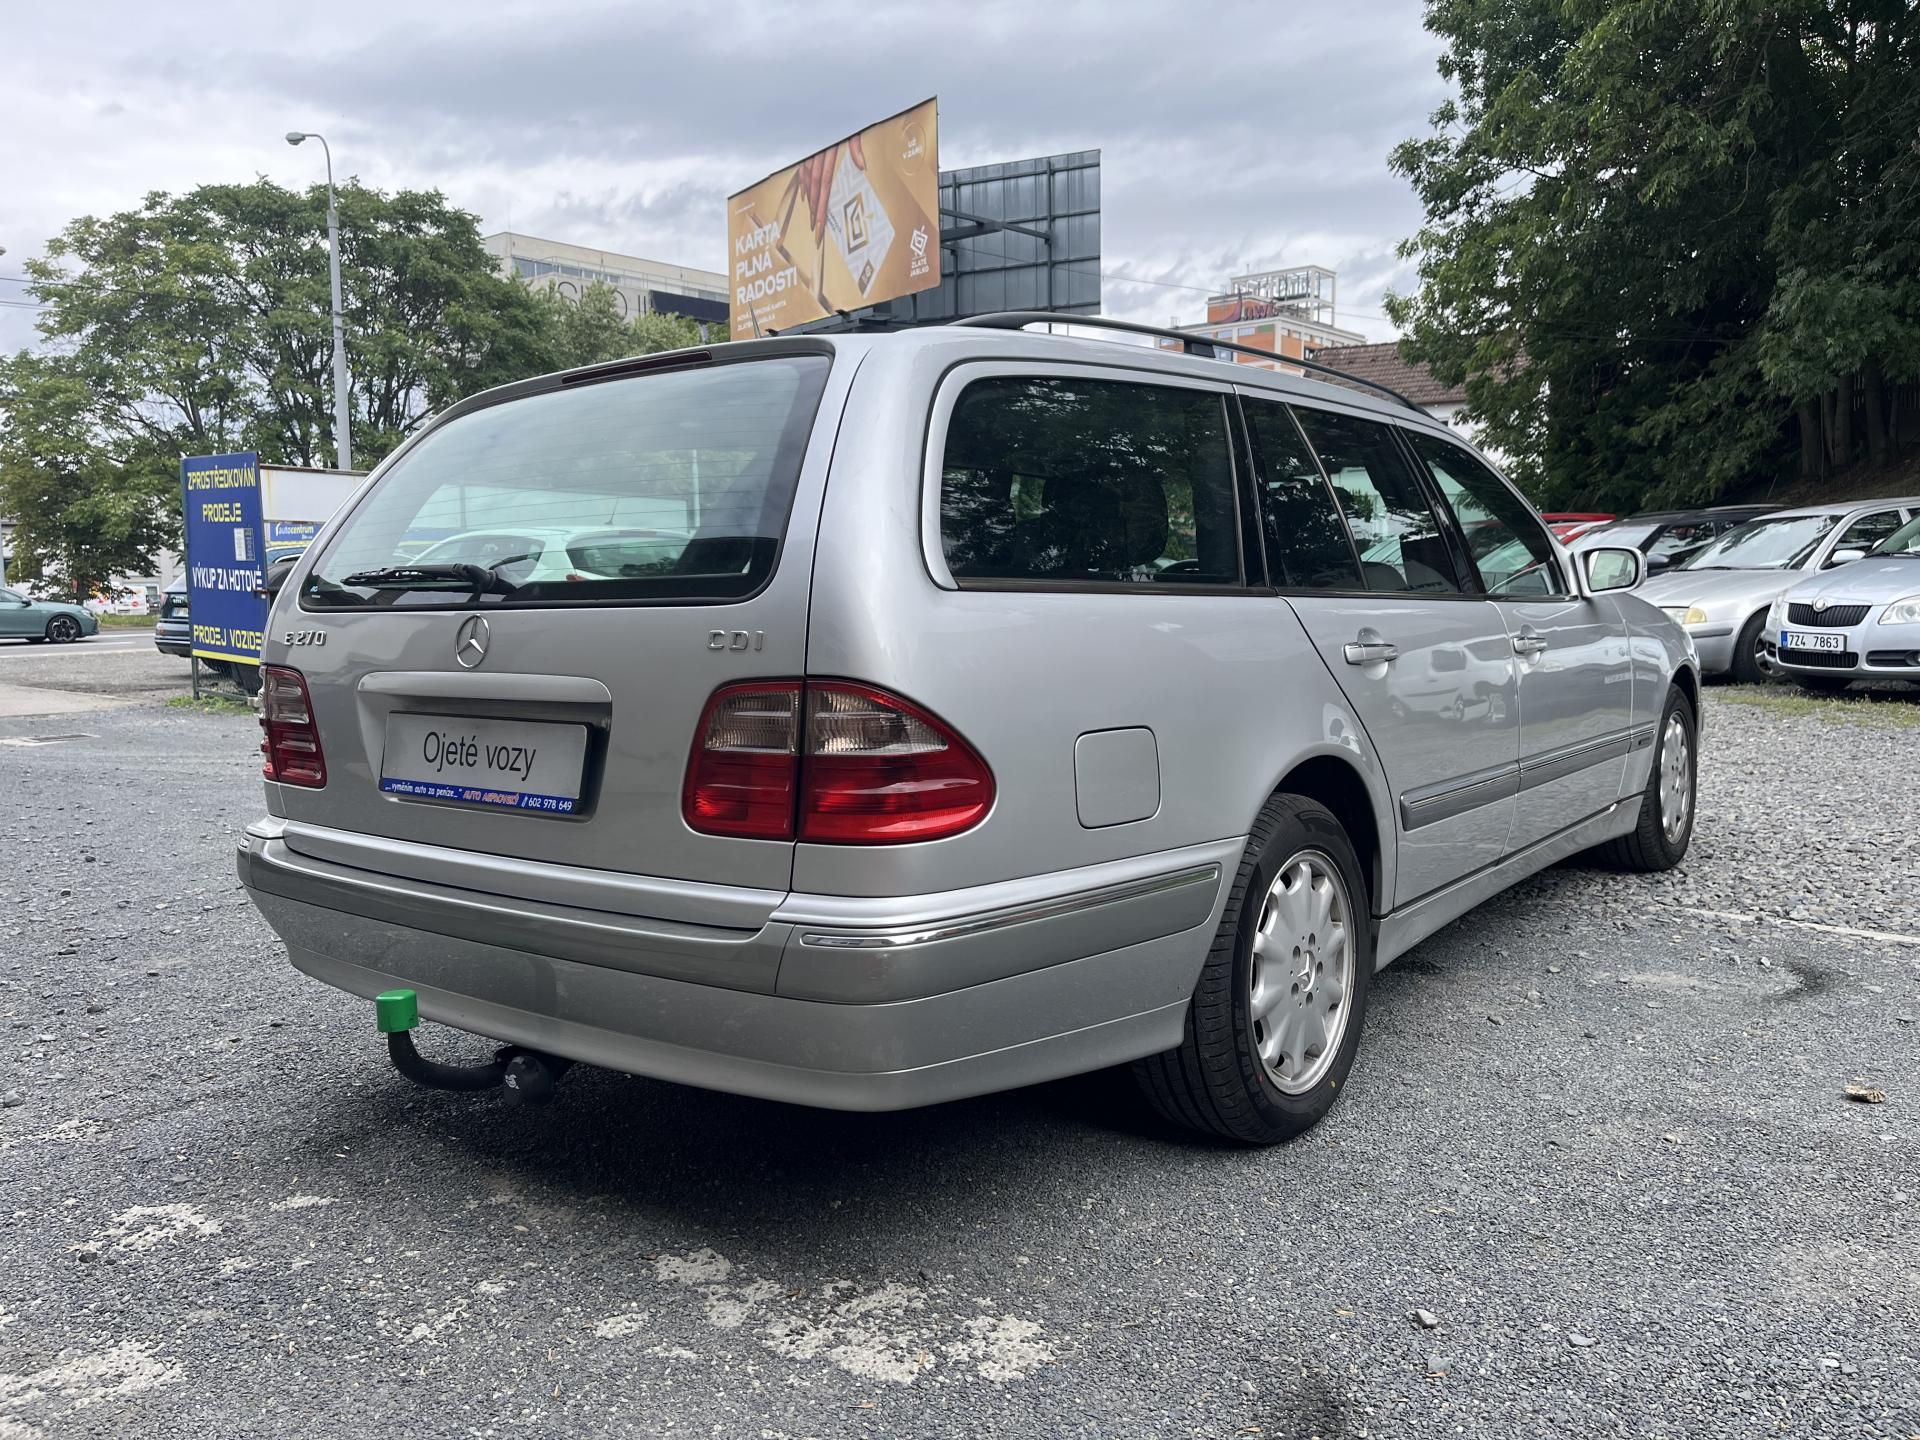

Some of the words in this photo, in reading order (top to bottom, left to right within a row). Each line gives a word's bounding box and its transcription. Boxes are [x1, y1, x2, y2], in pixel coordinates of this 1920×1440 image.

[735, 222, 780, 256] KARTA
[736, 246, 773, 280] PLNÁ
[737, 266, 797, 307] RADOSTI
[187, 461, 256, 490] ZPROSTŘEDKOVÁNÍ
[202, 502, 242, 522] PRODEJE
[192, 561, 216, 589] VÝKUP
[217, 568, 229, 590] ZA
[229, 564, 263, 592] HOTOVÉ
[193, 624, 227, 647] PRODEJ
[707, 629, 764, 652] CDI
[1789, 634, 1806, 647] 7Z4
[1813, 636, 1839, 649] 7863
[423, 731, 478, 772] Ojeté
[486, 744, 536, 782] vozy
[414, 785, 427, 794] auto
[528, 797, 541, 807] 602
[543, 798, 557, 809] 978
[558, 800, 573, 811] 649
